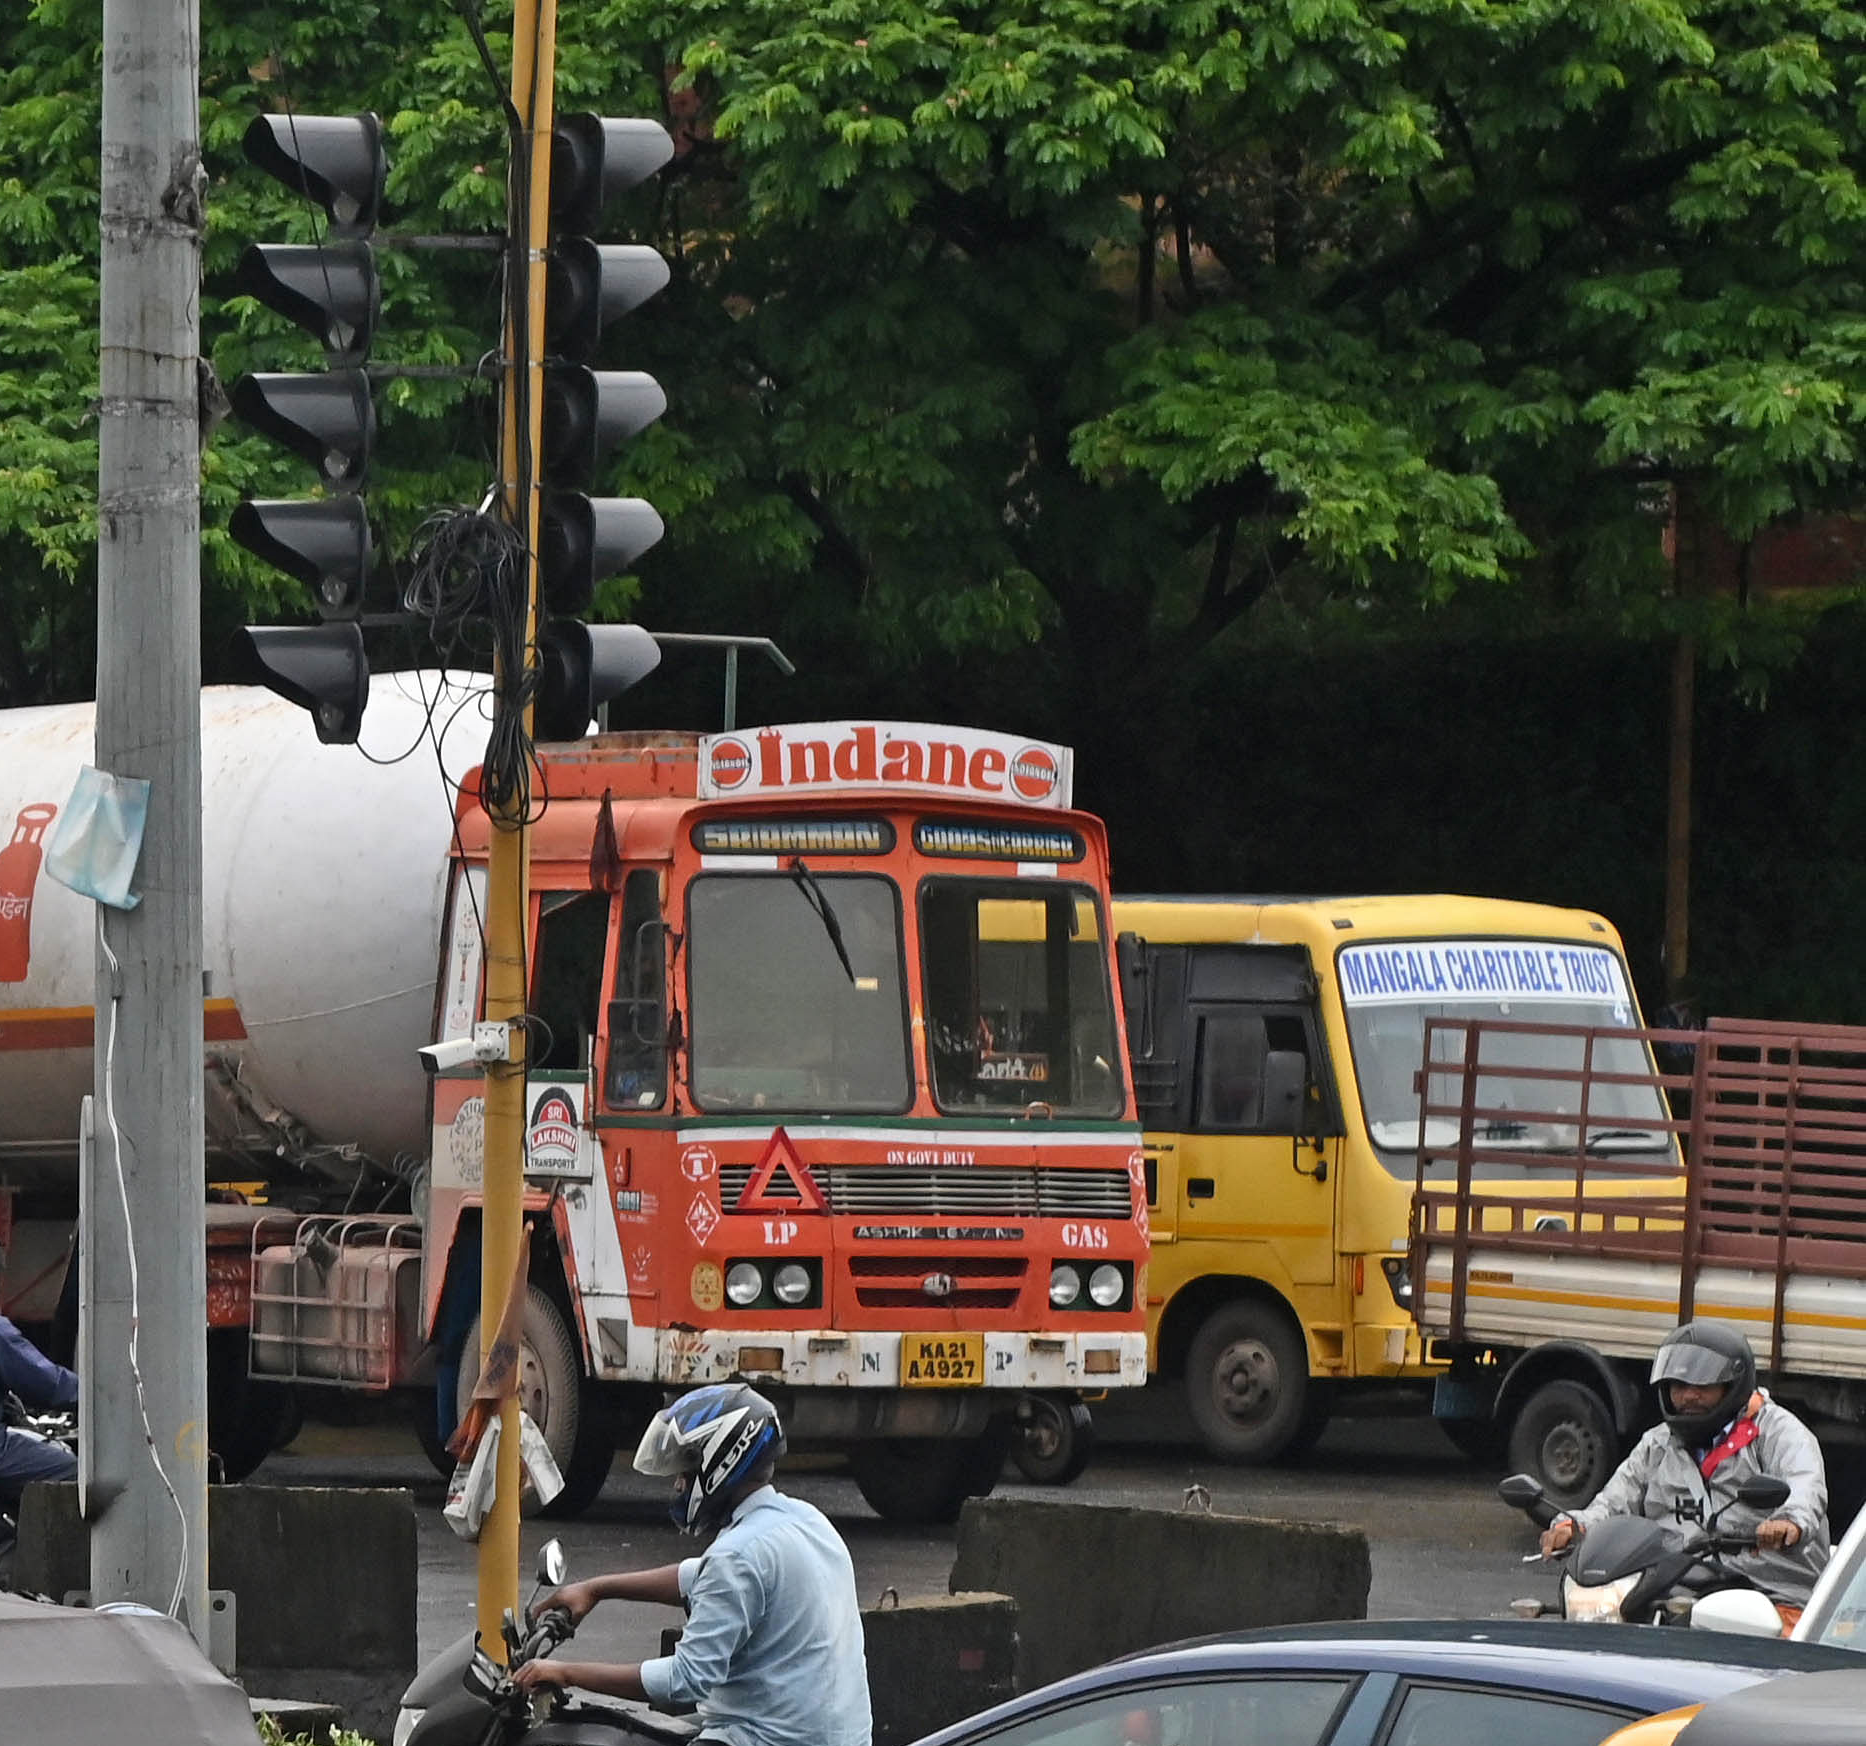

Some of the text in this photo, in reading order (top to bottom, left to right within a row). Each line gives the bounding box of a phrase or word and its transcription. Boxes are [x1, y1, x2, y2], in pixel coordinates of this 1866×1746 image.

[756, 726, 1007, 793] Indane
[1343, 949, 1616, 995] MANGALA CHARITABLE TRUST
[547, 1105, 563, 1119] SRI
[531, 1128, 577, 1151] LAKSHMI
[531, 1157, 575, 1169] TRANSPORTS
[887, 1151, 905, 1164] ON
[943, 1151, 976, 1166] DUTY
[857, 1226, 922, 1239] ASHOK
[1061, 1223, 1109, 1249] GAS
[908, 1360, 975, 1379] A4927
